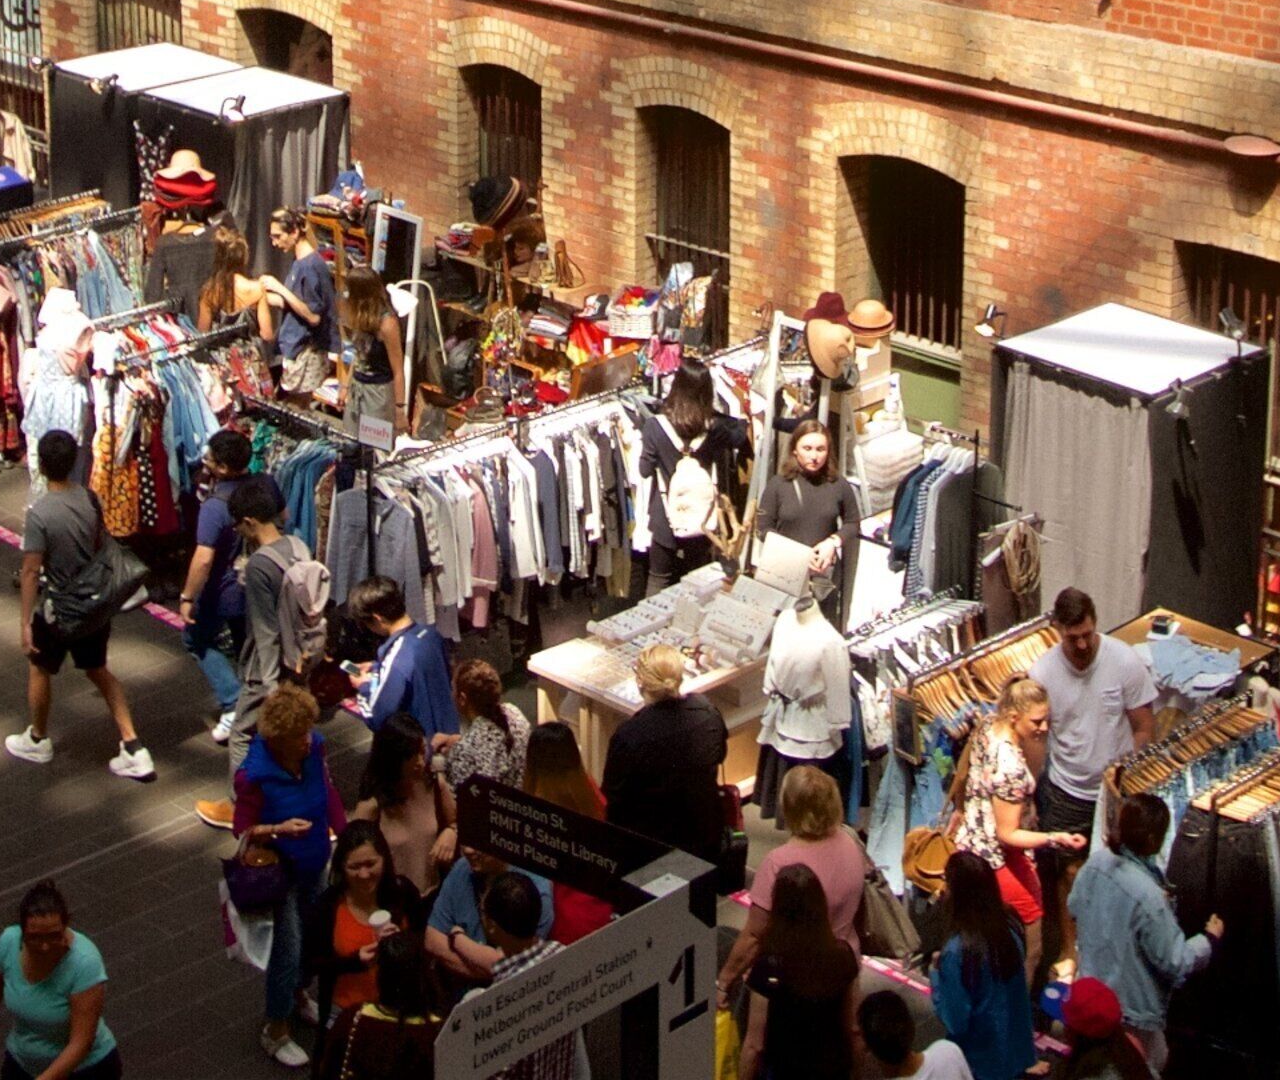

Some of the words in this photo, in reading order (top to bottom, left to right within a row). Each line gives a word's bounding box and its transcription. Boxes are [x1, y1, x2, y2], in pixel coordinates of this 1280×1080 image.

[488, 789, 548, 825] Swanston
[550, 812, 569, 832] St.
[488, 810, 521, 834] RMIT
[524, 825, 534, 839] &
[536, 828, 569, 854] State
[571, 841, 619, 875] Library
[489, 830, 521, 856] Knox
[523, 843, 559, 871] Place
[471, 1003, 493, 1023] Via
[495, 969, 557, 1012] Escalator
[472, 1038, 514, 1070] Lower
[516, 1007, 564, 1046] Ground
[566, 990, 597, 1017] Food
[599, 970, 634, 999] Court
[473, 1000, 544, 1048] Melbourne
[546, 968, 593, 1006] Central
[595, 948, 638, 980] Station
[668, 943, 710, 1034] 1
